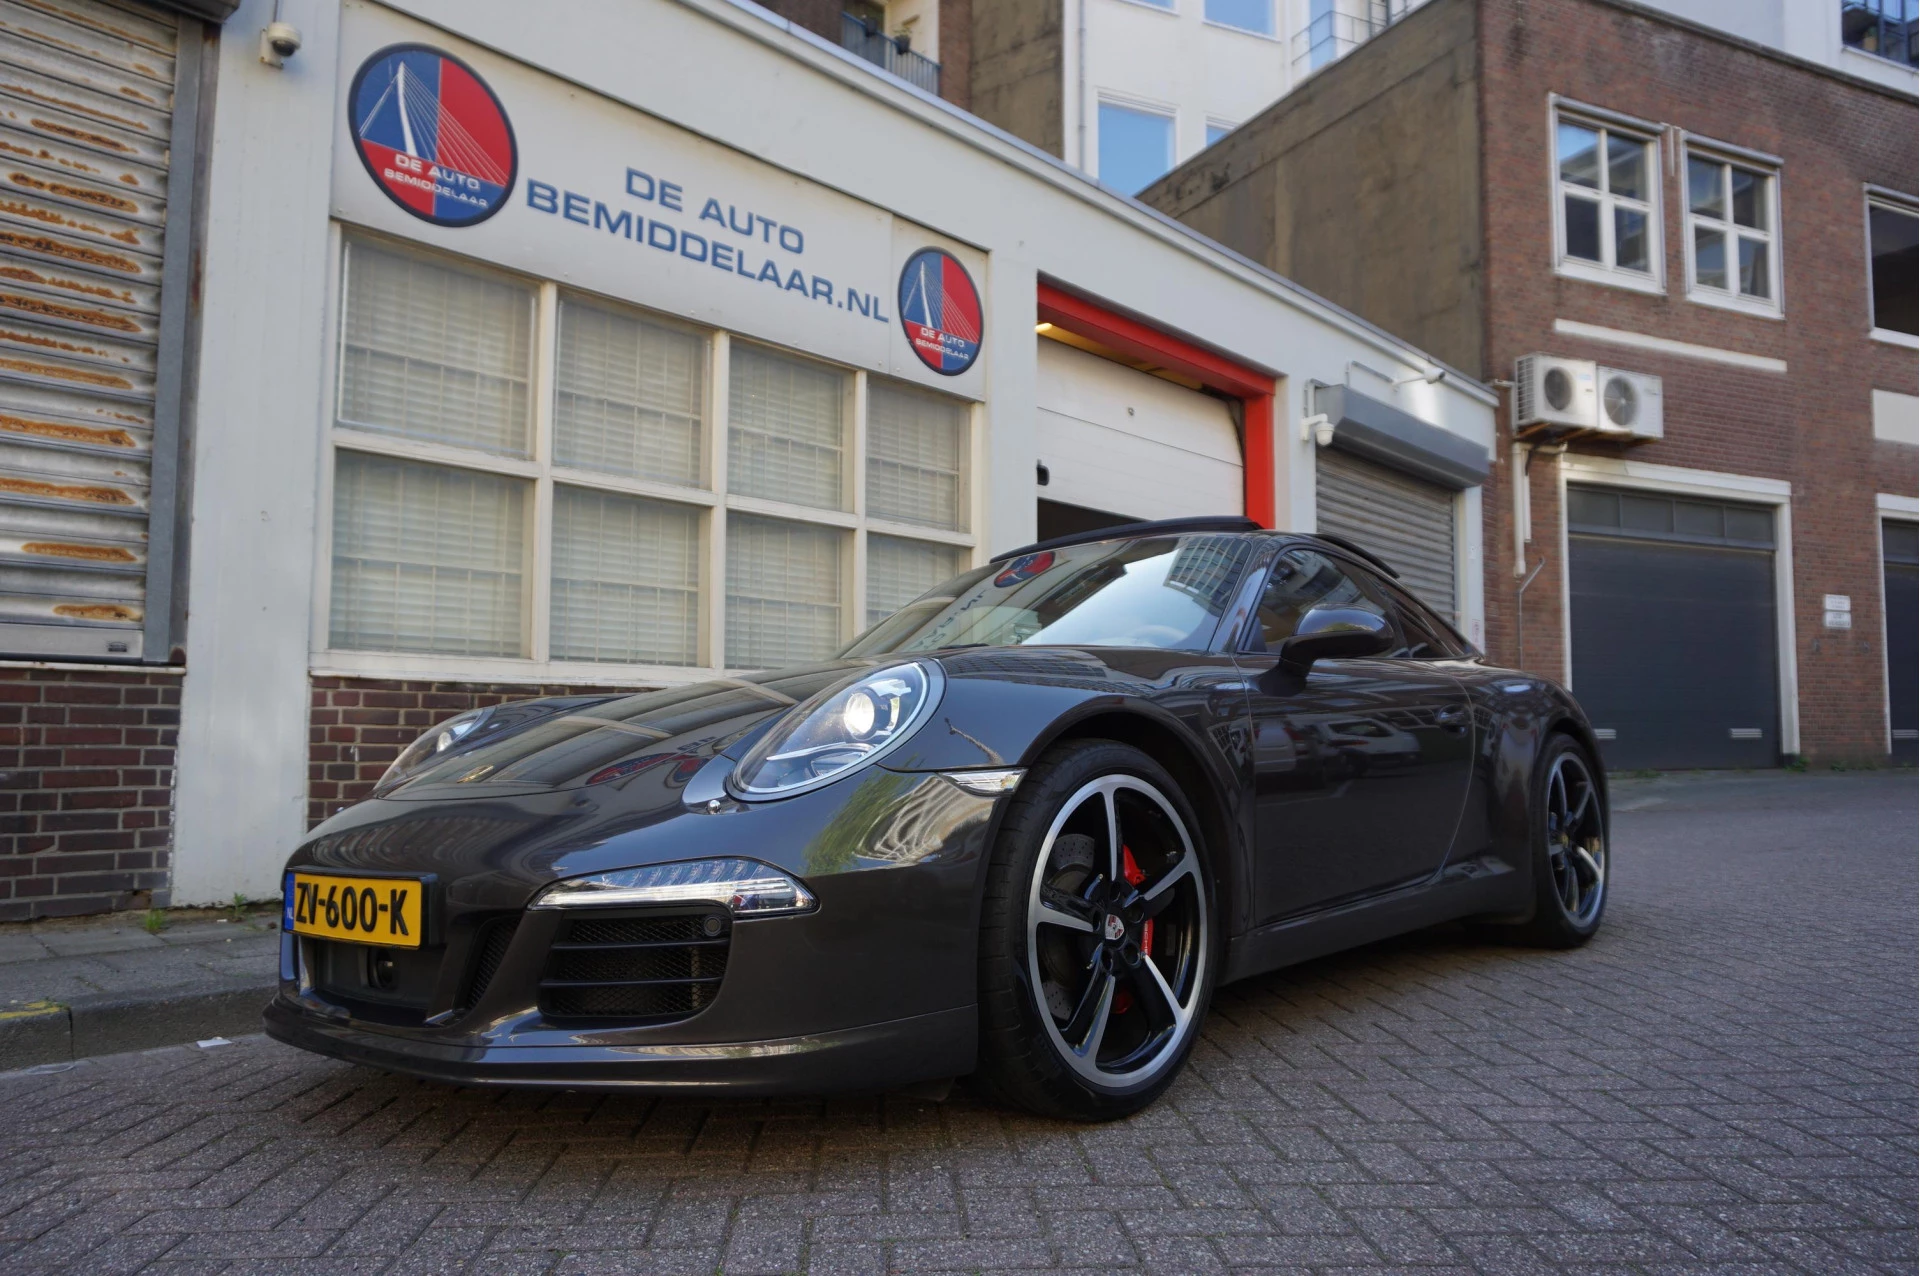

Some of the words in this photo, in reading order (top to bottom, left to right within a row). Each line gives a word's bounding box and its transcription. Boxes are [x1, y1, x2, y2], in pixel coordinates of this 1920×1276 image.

[384, 168, 489, 208] BEMIDDELAAR
[395, 153, 422, 172] DE
[428, 165, 480, 190] AUTO
[626, 166, 683, 212] DE
[699, 198, 804, 255] AUTO
[526, 178, 889, 323] BEMIDDELAAR.NL
[916, 338, 968, 359] BEMIDDELAAR
[921, 327, 935, 339] DE
[937, 334, 964, 347] AUTO
[286, 907, 294, 920] NL
[296, 882, 409, 936] ZV-600-K
